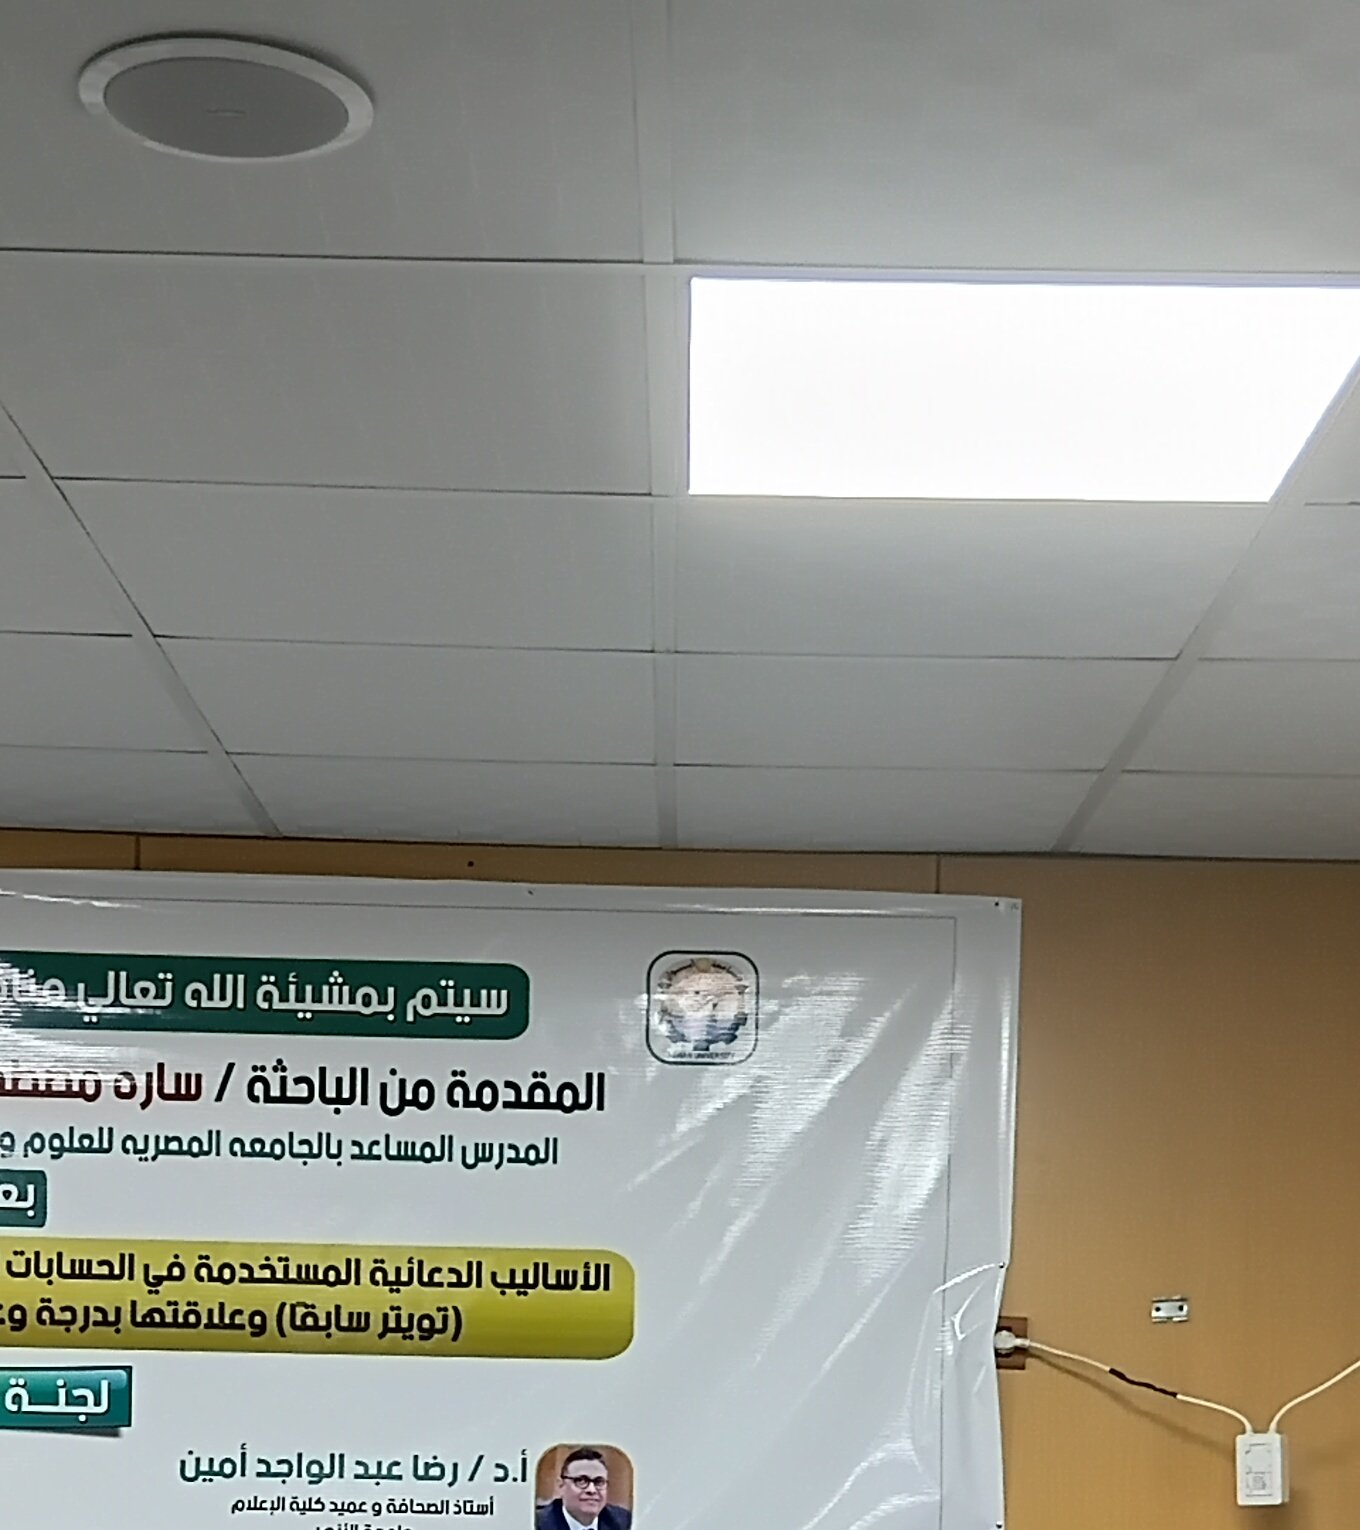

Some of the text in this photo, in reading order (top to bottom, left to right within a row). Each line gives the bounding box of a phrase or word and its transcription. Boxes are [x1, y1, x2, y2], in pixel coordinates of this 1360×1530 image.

[184, 972, 245, 1010] الله
[255, 971, 396, 1020] بمشيئة
[405, 976, 510, 1022] سيتم
[245, 1059, 370, 1117] الباحثة
[380, 1067, 436, 1116] من
[445, 1071, 607, 1115] المقدمة
[23, 1125, 114, 1160] للعلوم
[121, 1129, 221, 1163] المصريه
[228, 1131, 343, 1167] بالجامعه
[350, 1133, 454, 1164] المساعد
[461, 1136, 558, 1171] المدرس
[5, 1250, 135, 1286] الحسابات
[143, 1253, 186, 1289] في
[193, 1254, 362, 1288] المستخدمة
[369, 1256, 483, 1294] الدعائية
[490, 1261, 611, 1296] الأساليب
[35, 1296, 122, 1336] بدرجة
[129, 1299, 269, 1338] وعلاقتها
[179, 1442, 528, 1488] أ.د رضا عبد الواجد أمين
[231, 1495, 494, 1517] أستاذ الصحافة عميد كلية الإعلام
